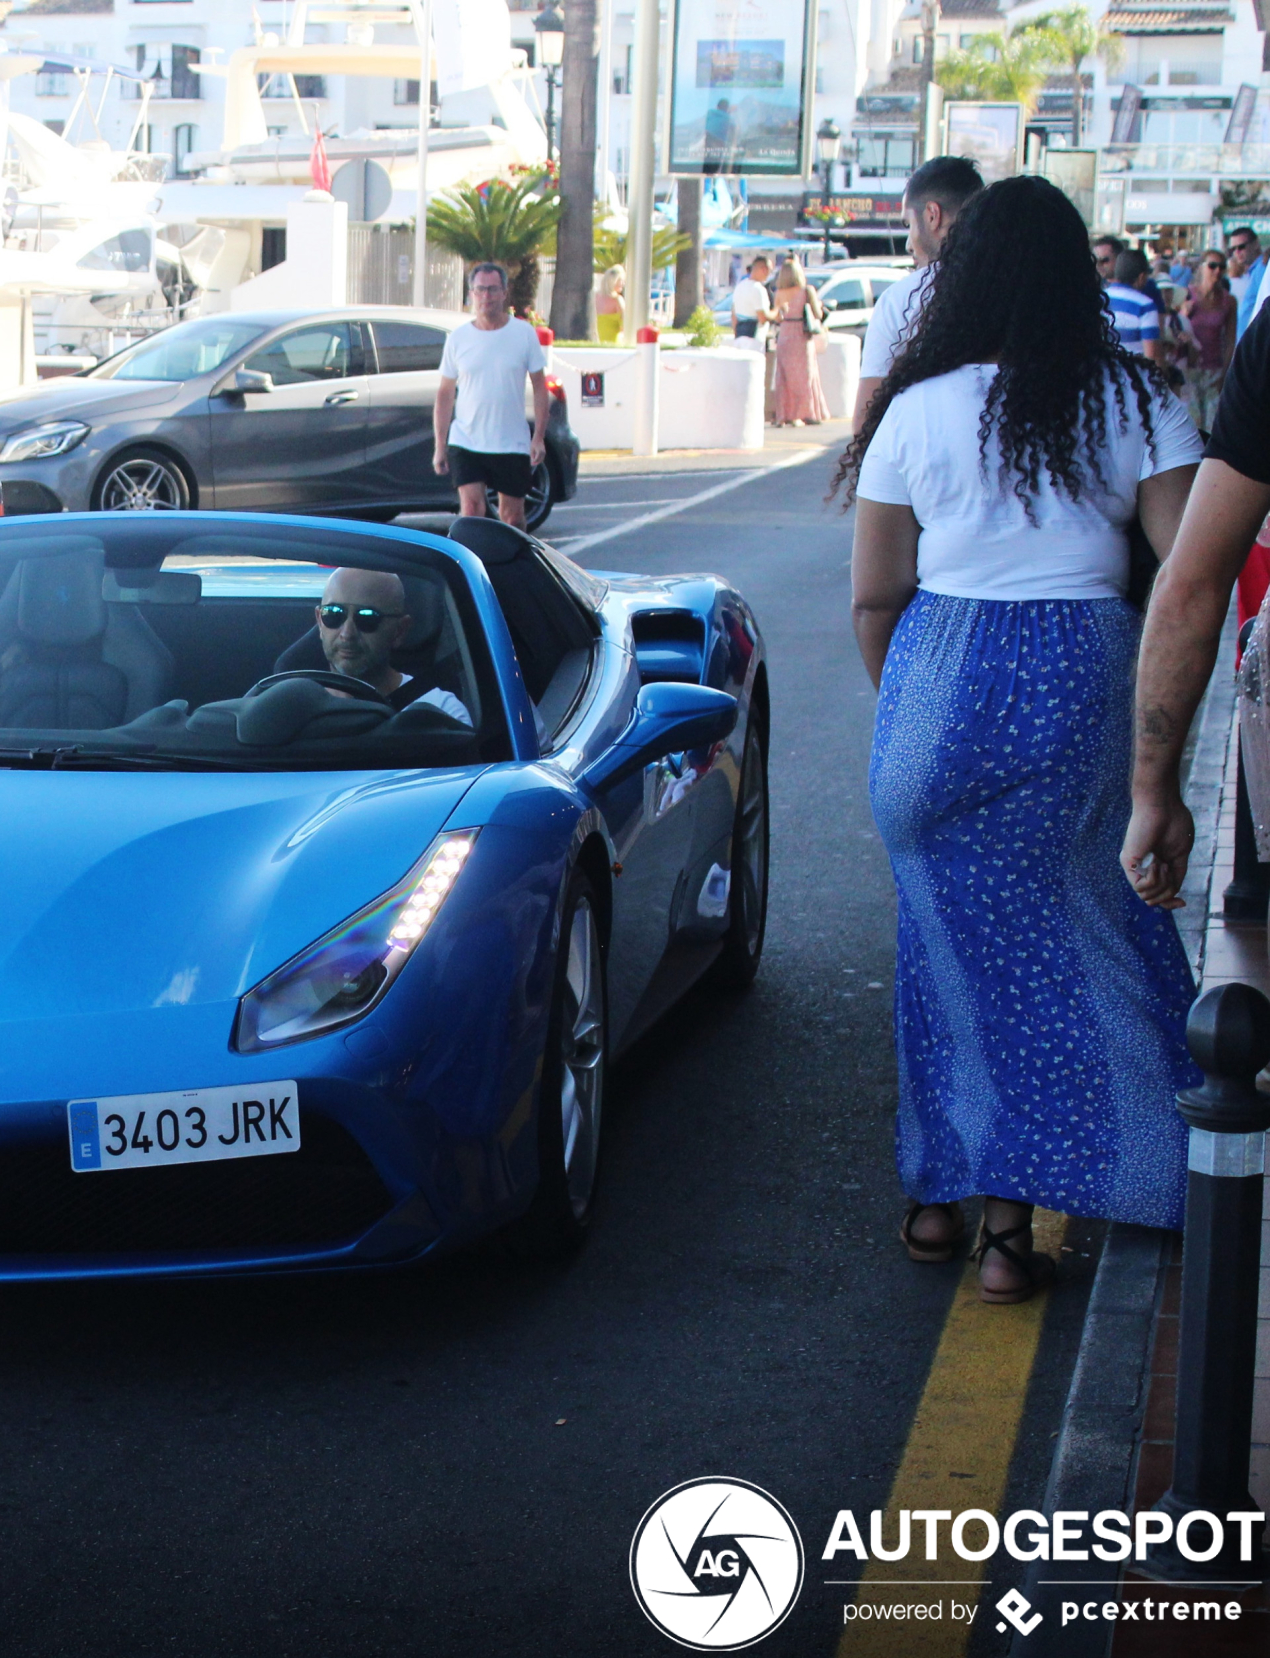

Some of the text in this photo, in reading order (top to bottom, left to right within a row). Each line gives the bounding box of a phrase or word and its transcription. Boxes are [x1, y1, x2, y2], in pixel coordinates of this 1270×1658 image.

[80, 1096, 293, 1158] E 3403 JRK
